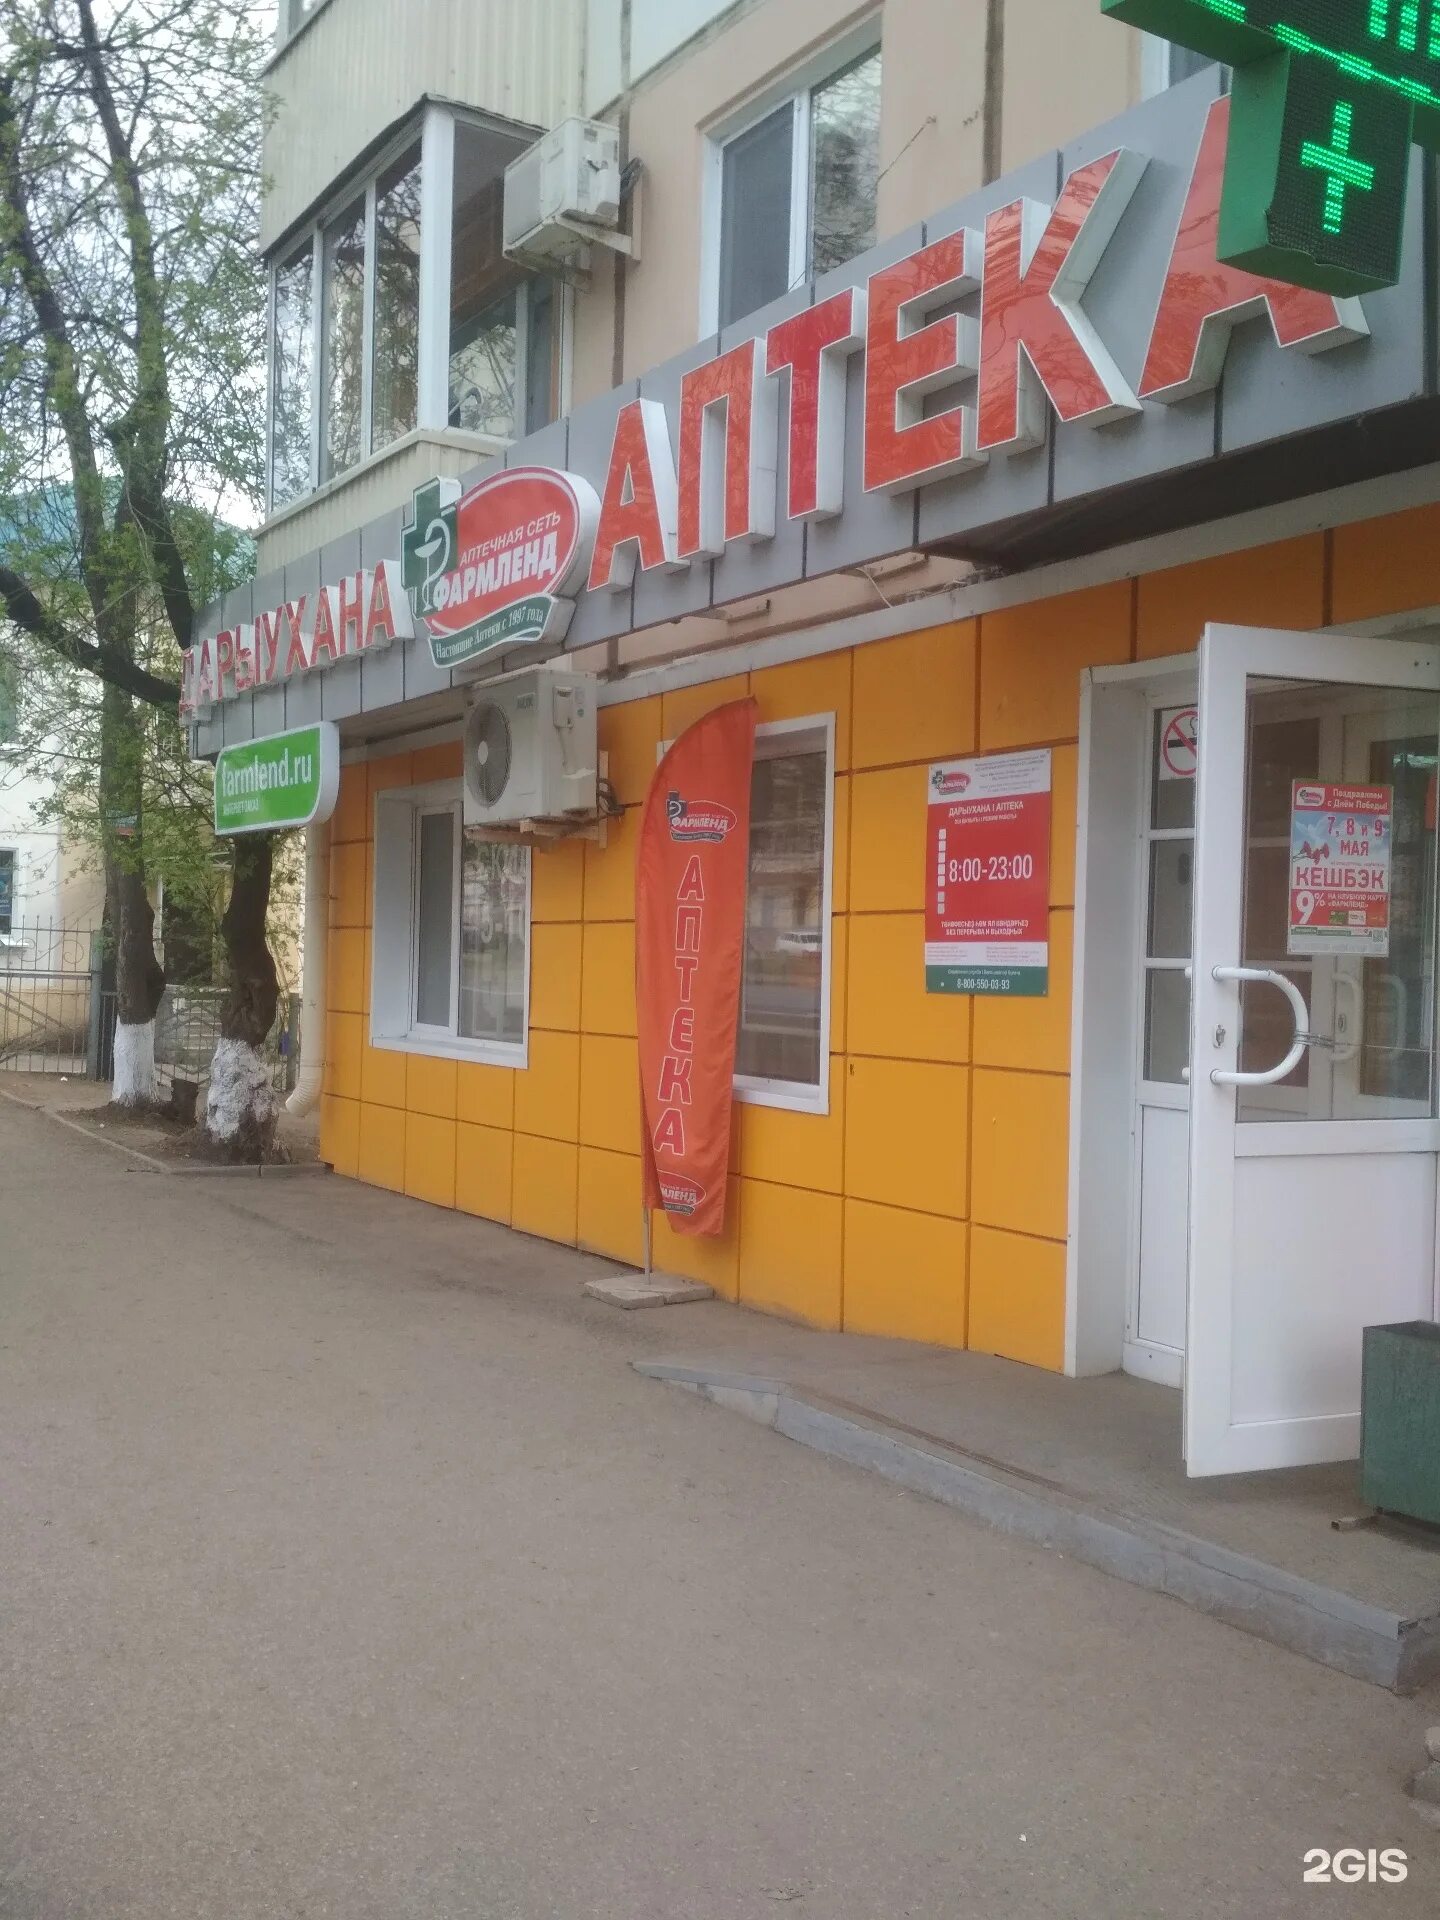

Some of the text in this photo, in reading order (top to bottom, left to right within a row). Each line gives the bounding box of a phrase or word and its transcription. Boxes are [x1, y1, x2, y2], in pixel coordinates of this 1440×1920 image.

[587, 94, 1340, 592] АПТЕКА
[460, 512, 561, 567] АПТЕЧНАЯ СЕТЬ
[433, 531, 558, 610] ФАРМЛЕНД
[179, 559, 398, 716] ДАРЫУХАНА
[435, 606, 544, 660] Настоящие Аптеки с 1997 года
[222, 747, 312, 798] farmlend.ru
[1333, 788, 1383, 799] Поздравляем
[672, 817, 729, 831] ФАРМЛЕНД
[948, 804, 991, 818] ДАРЫУХАНА
[996, 801, 1024, 812] АПТЕКА
[1328, 816, 1384, 838] 7, 8 и 9
[1340, 839, 1370, 857] МАЯ
[949, 854, 1033, 883] 8:00-23:00
[1296, 866, 1385, 890] КЕШБЭК
[956, 977, 1011, 990] 8-800-550-03-93
[653, 854, 705, 1157] АПТЕКА
